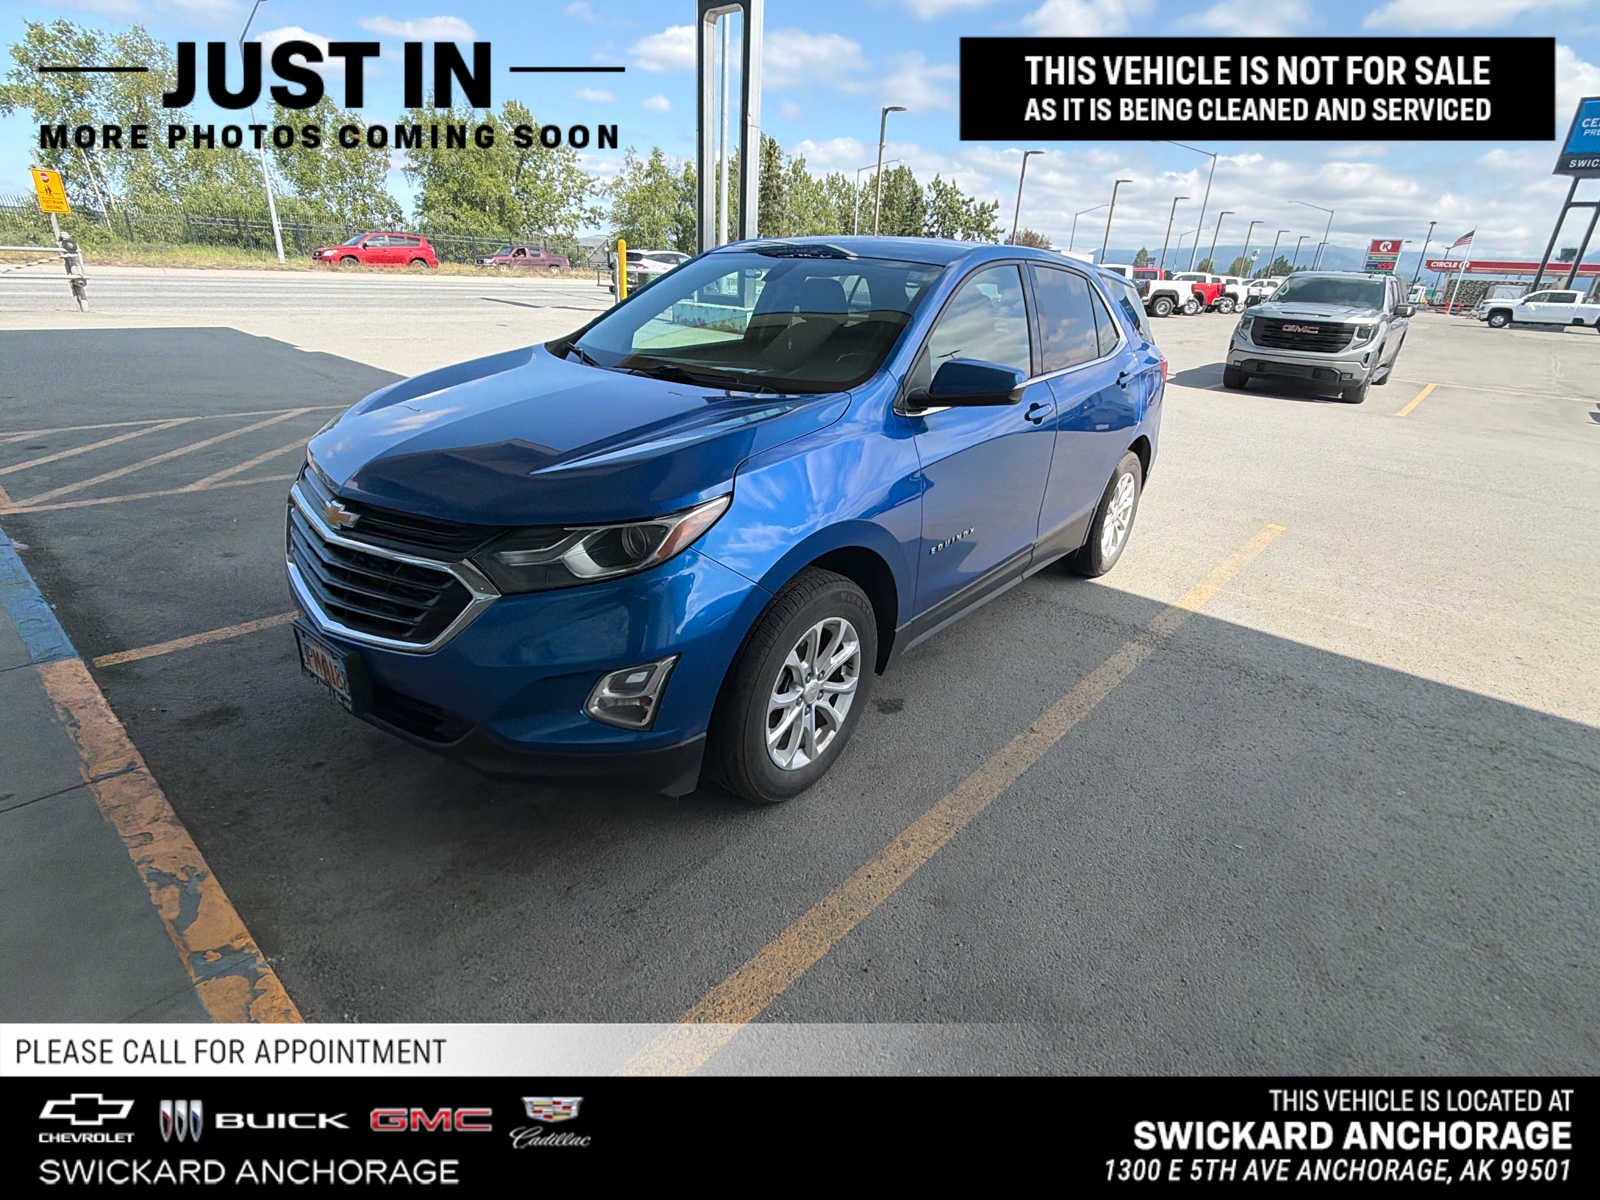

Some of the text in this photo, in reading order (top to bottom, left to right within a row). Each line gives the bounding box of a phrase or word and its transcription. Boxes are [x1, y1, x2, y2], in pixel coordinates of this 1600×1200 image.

[1582, 118, 1600, 127] CE
[1569, 159, 1600, 168] SWIC
[1281, 324, 1320, 335] GMC
[929, 527, 975, 555] EQUINOX
